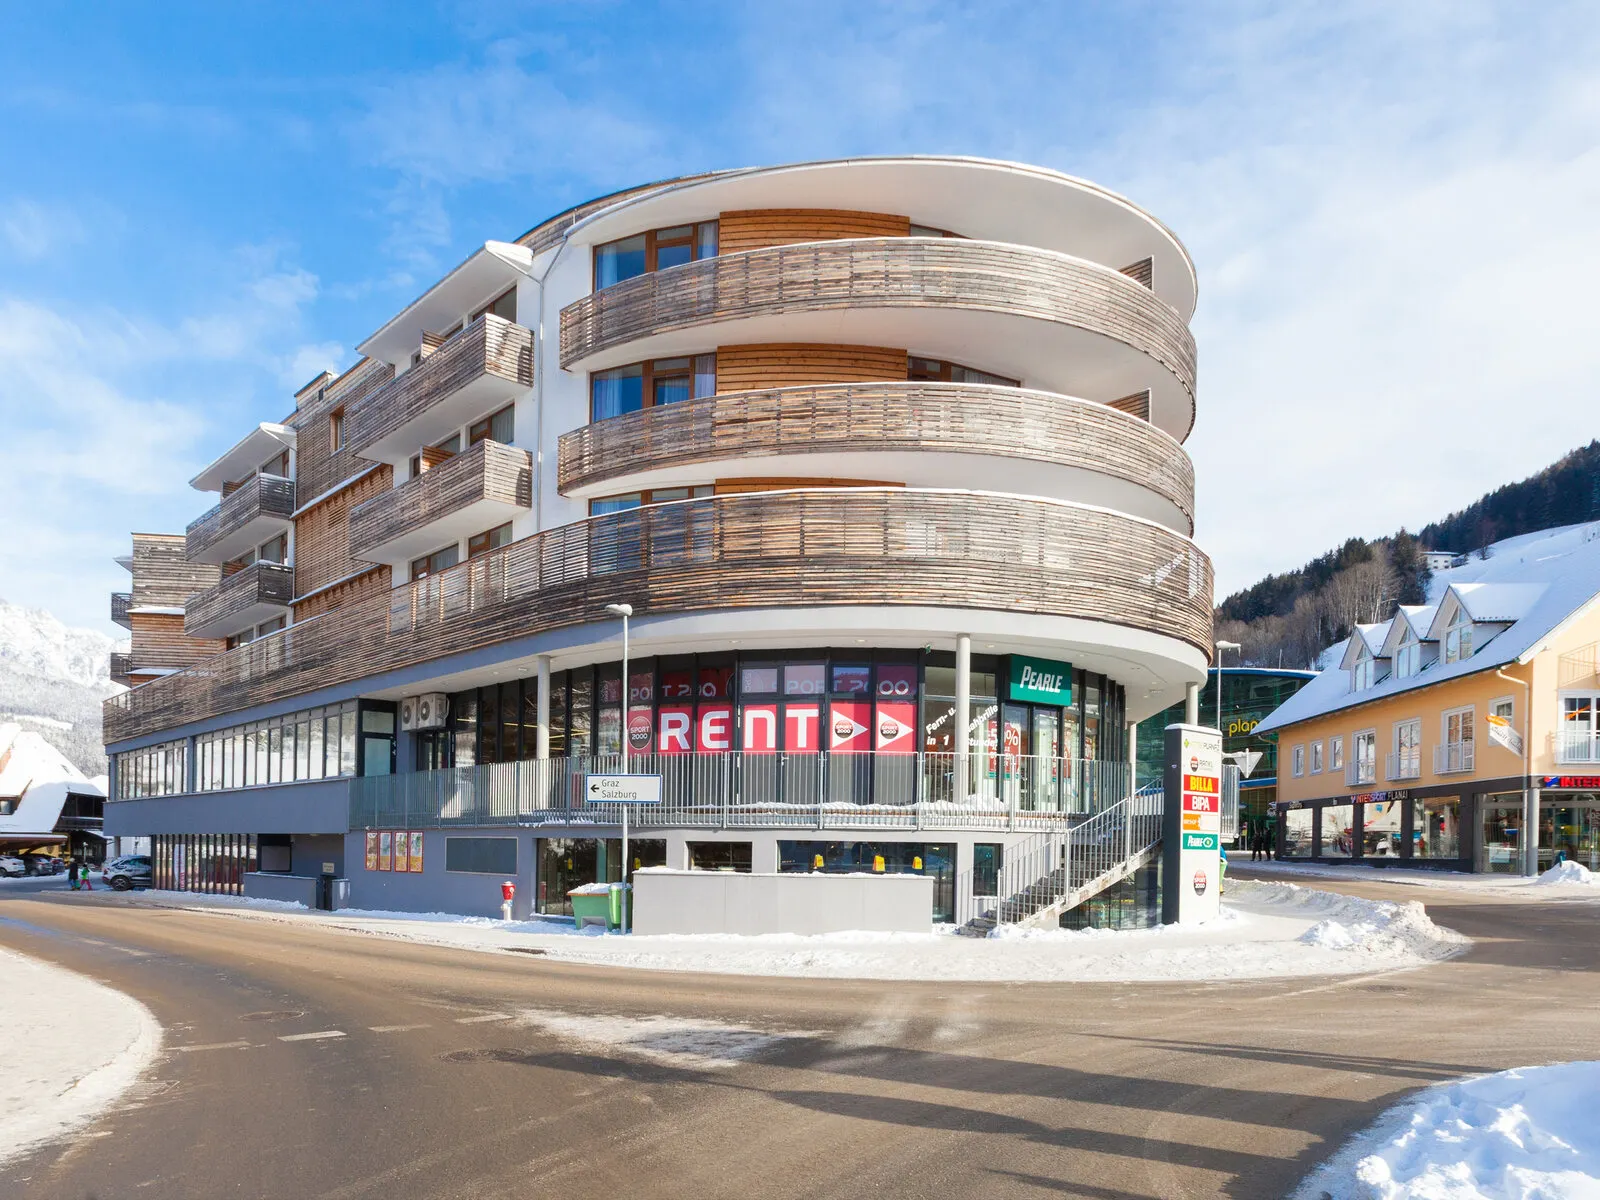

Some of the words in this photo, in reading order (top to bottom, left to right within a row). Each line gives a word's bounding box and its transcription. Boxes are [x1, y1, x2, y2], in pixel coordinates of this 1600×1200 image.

[1020, 665, 1063, 694] PEARLE
[968, 704, 998, 733] ahbrille
[630, 725, 650, 734] SPORT
[943, 734, 950, 746] 1
[601, 779, 620, 788] Graz
[1190, 775, 1213, 793] BILLA
[601, 790, 638, 801] Salzburg
[1191, 795, 1211, 811] BIPA
